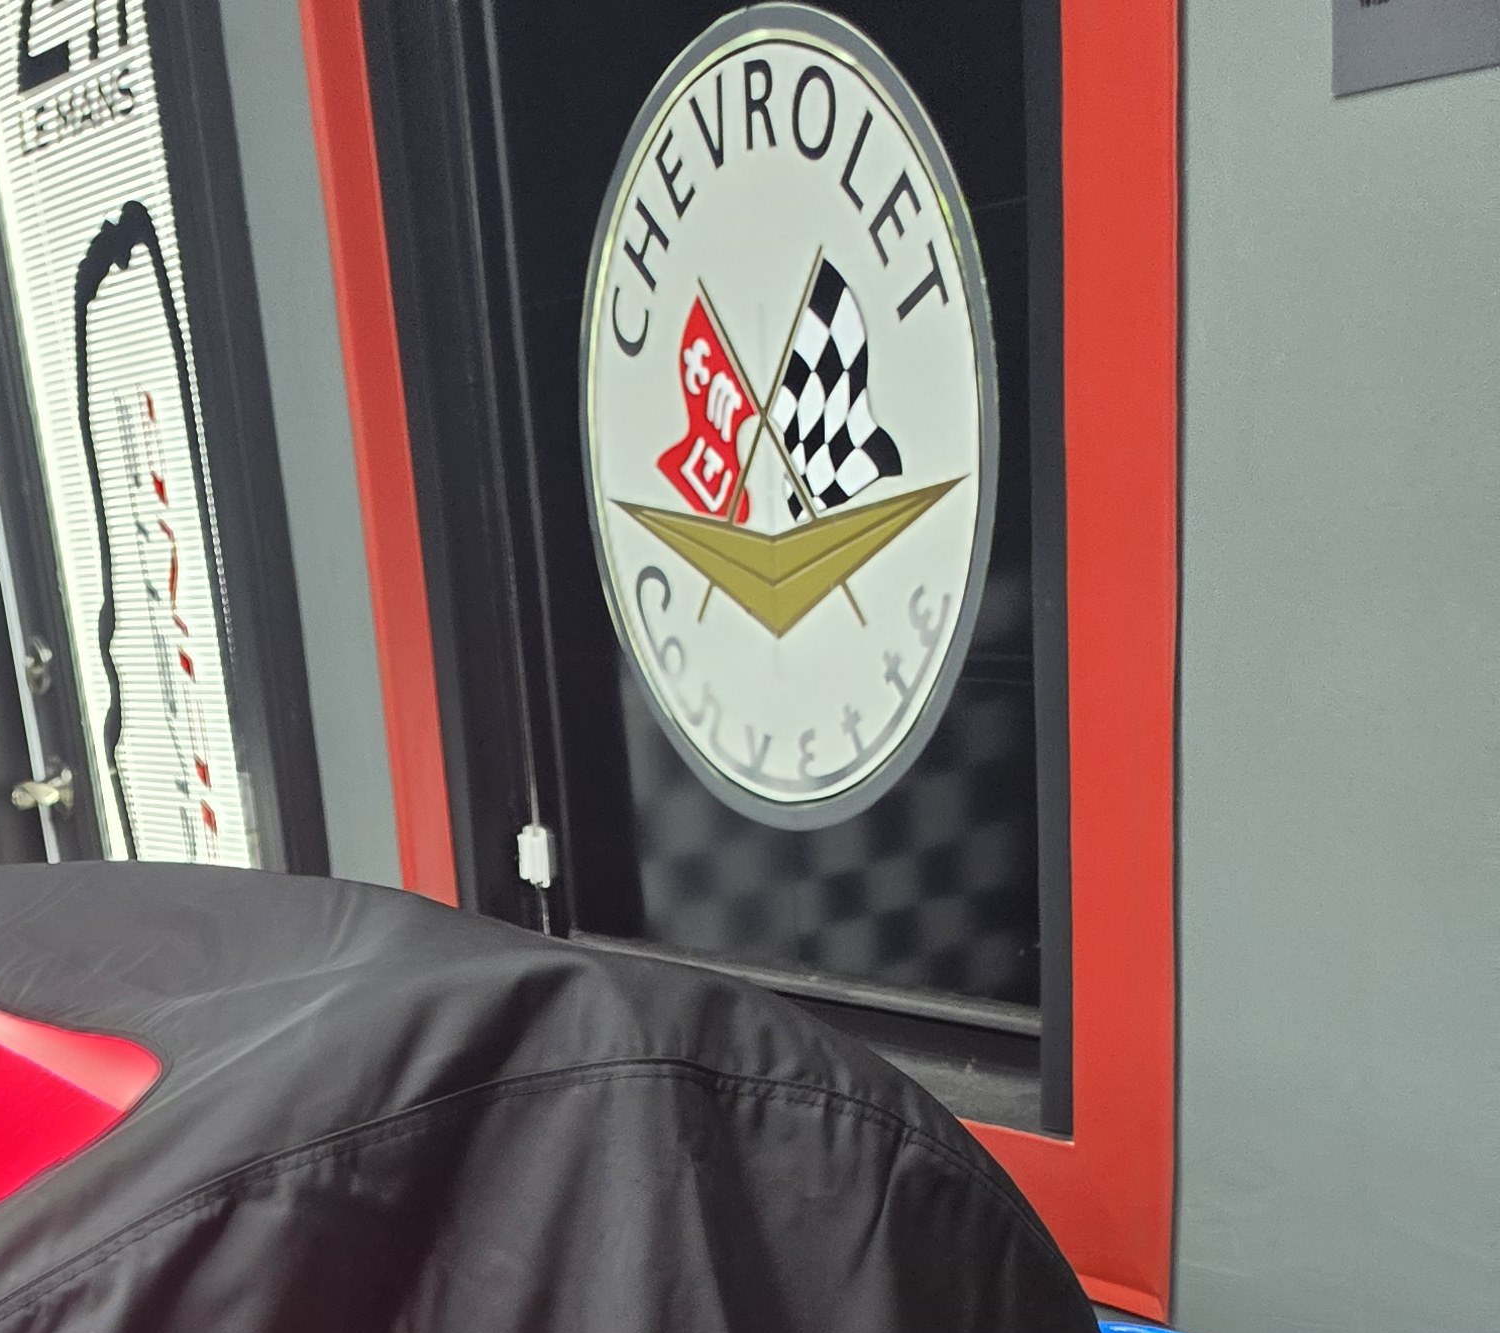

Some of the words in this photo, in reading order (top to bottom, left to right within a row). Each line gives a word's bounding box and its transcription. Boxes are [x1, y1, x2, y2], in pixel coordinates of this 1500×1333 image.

[20, 104, 50, 156] LE
[55, 67, 135, 141] MANS
[612, 59, 949, 357] CHEVROLET
